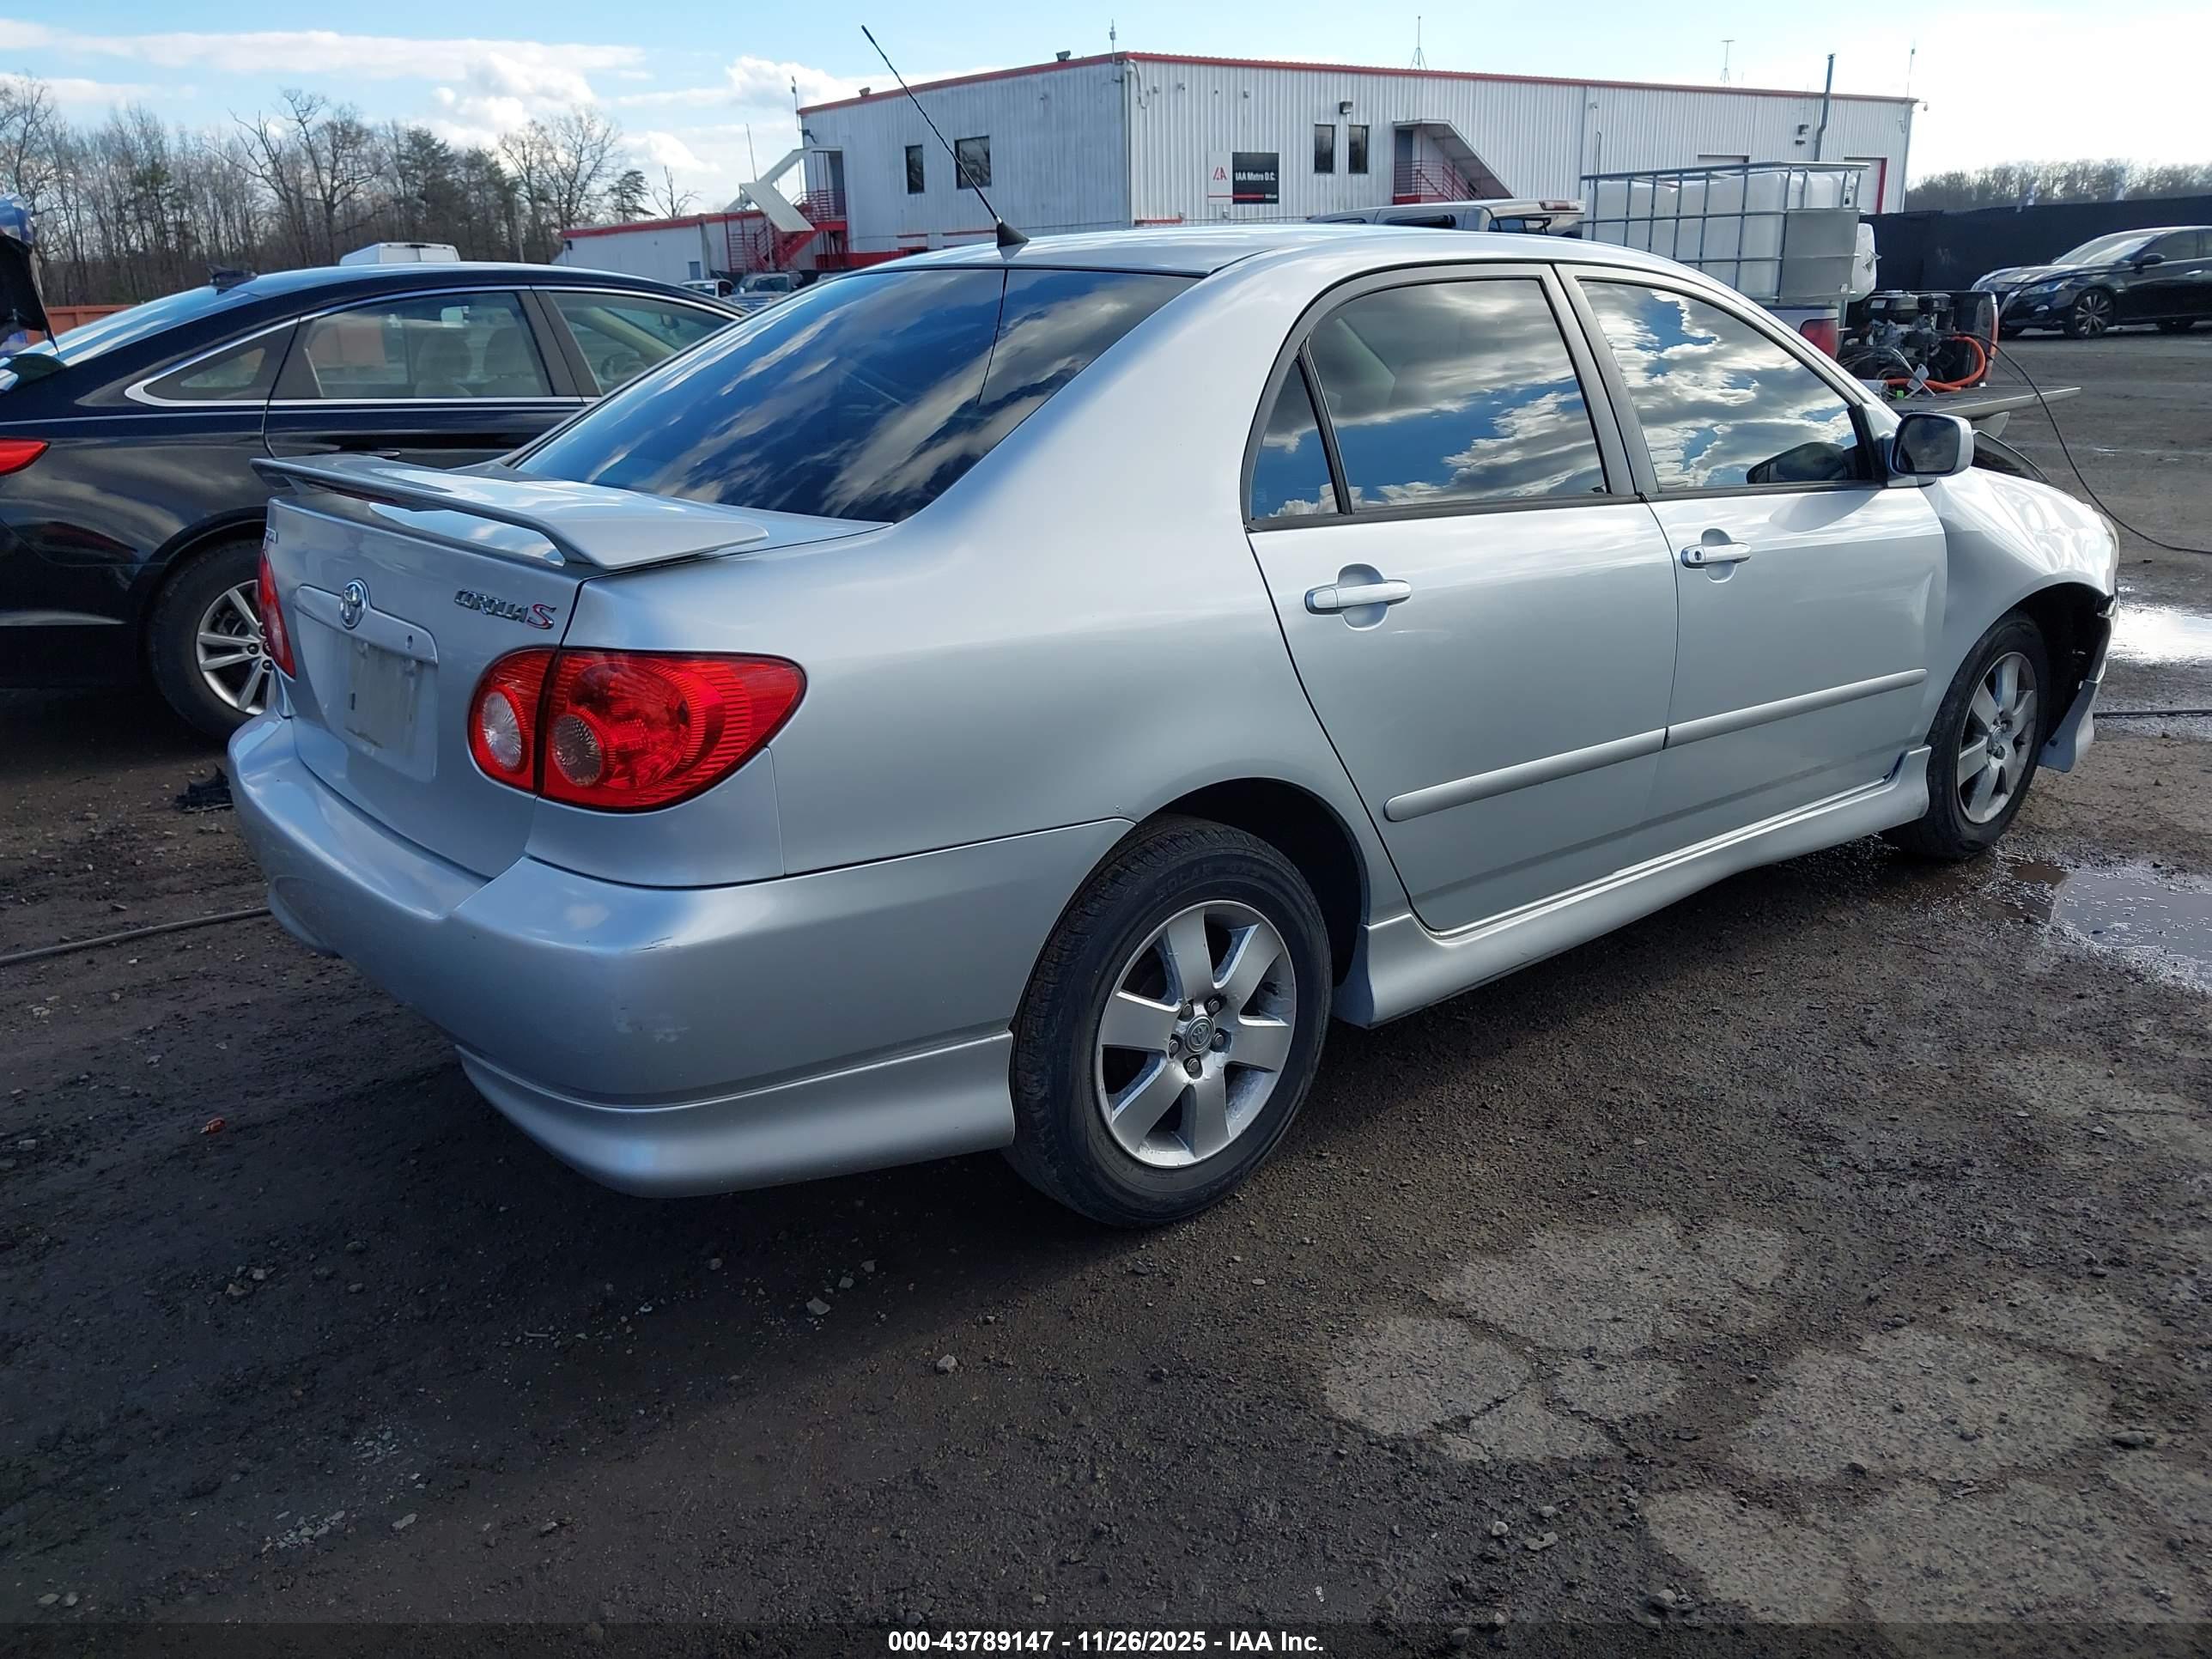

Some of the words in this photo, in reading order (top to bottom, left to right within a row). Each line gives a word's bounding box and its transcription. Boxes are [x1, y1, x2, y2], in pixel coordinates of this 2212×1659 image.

[1235, 172, 1247, 181] IAA
[1247, 172, 1264, 181] Metro
[453, 589, 529, 623] COROLLA
[526, 603, 557, 630] S
